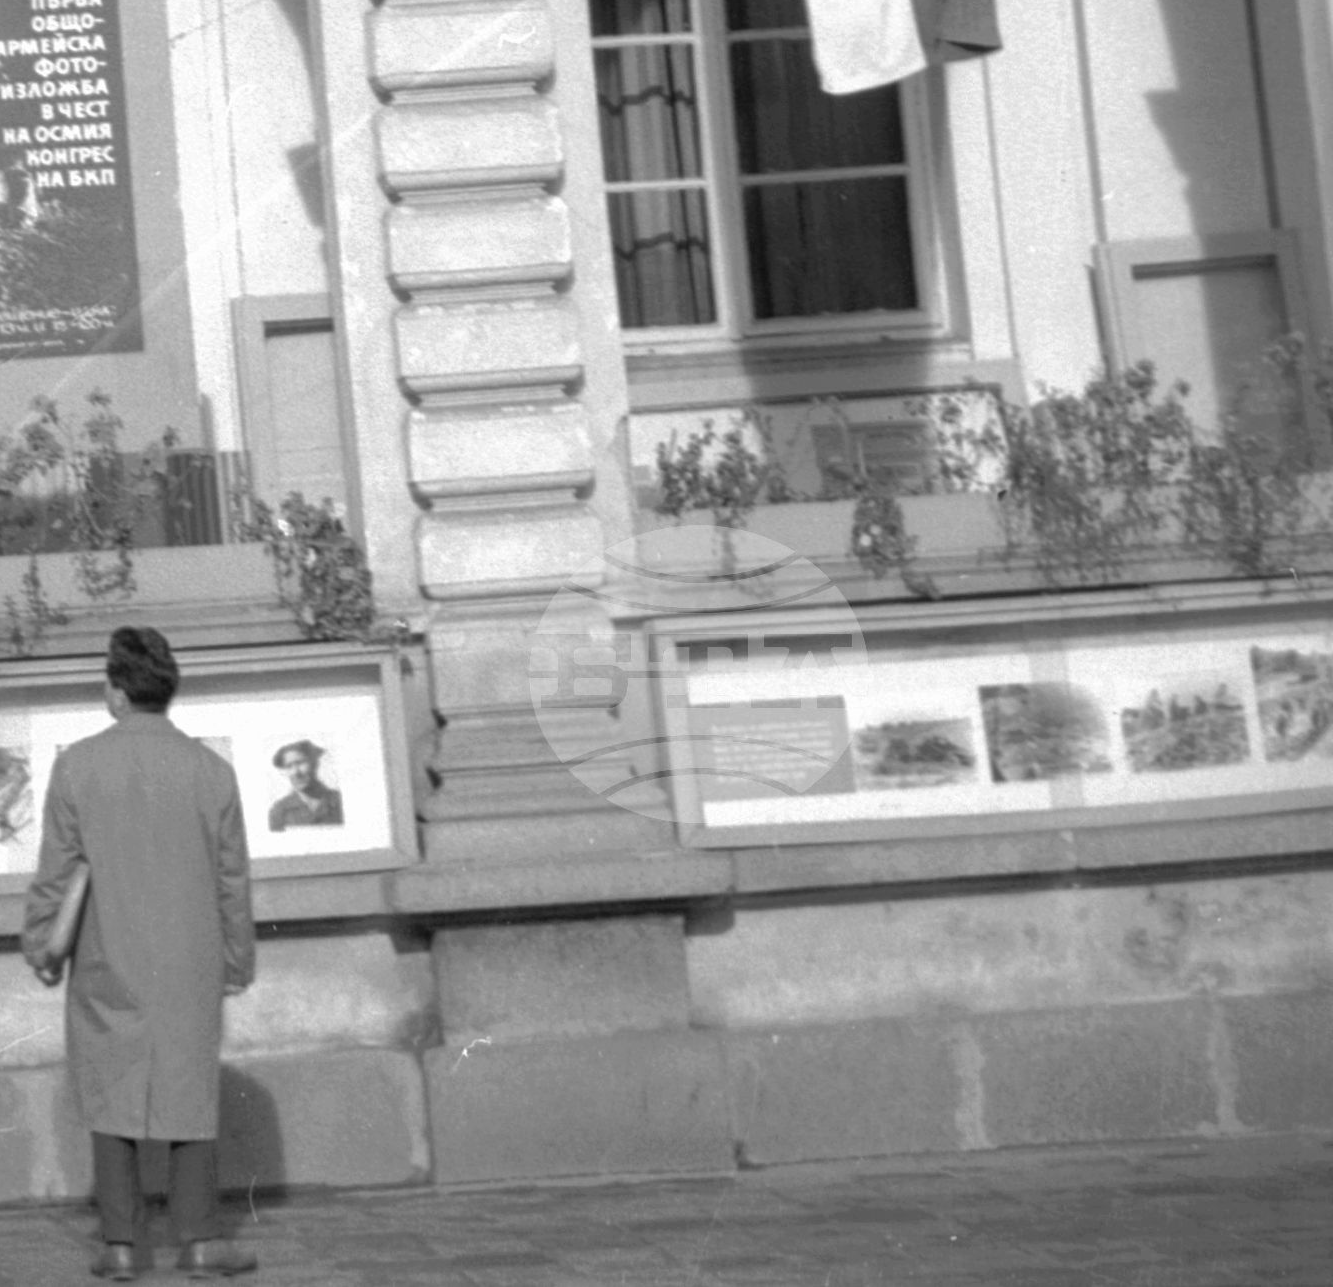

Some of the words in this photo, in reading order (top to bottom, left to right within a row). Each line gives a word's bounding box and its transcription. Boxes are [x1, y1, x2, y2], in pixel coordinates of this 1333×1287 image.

[31, 13, 105, 33] ОБЩО-
[34, 56, 107, 77] ФОТО-
[0, 78, 109, 99] ИЗЛОЖБА
[41, 103, 54, 120] В
[57, 100, 110, 118] ЧЕСТ
[3, 127, 31, 144] НА
[34, 123, 112, 143] ОСМИЯ
[26, 145, 115, 166] КОНГРЕС
[36, 170, 64, 187] НА
[68, 168, 115, 186] БКП
